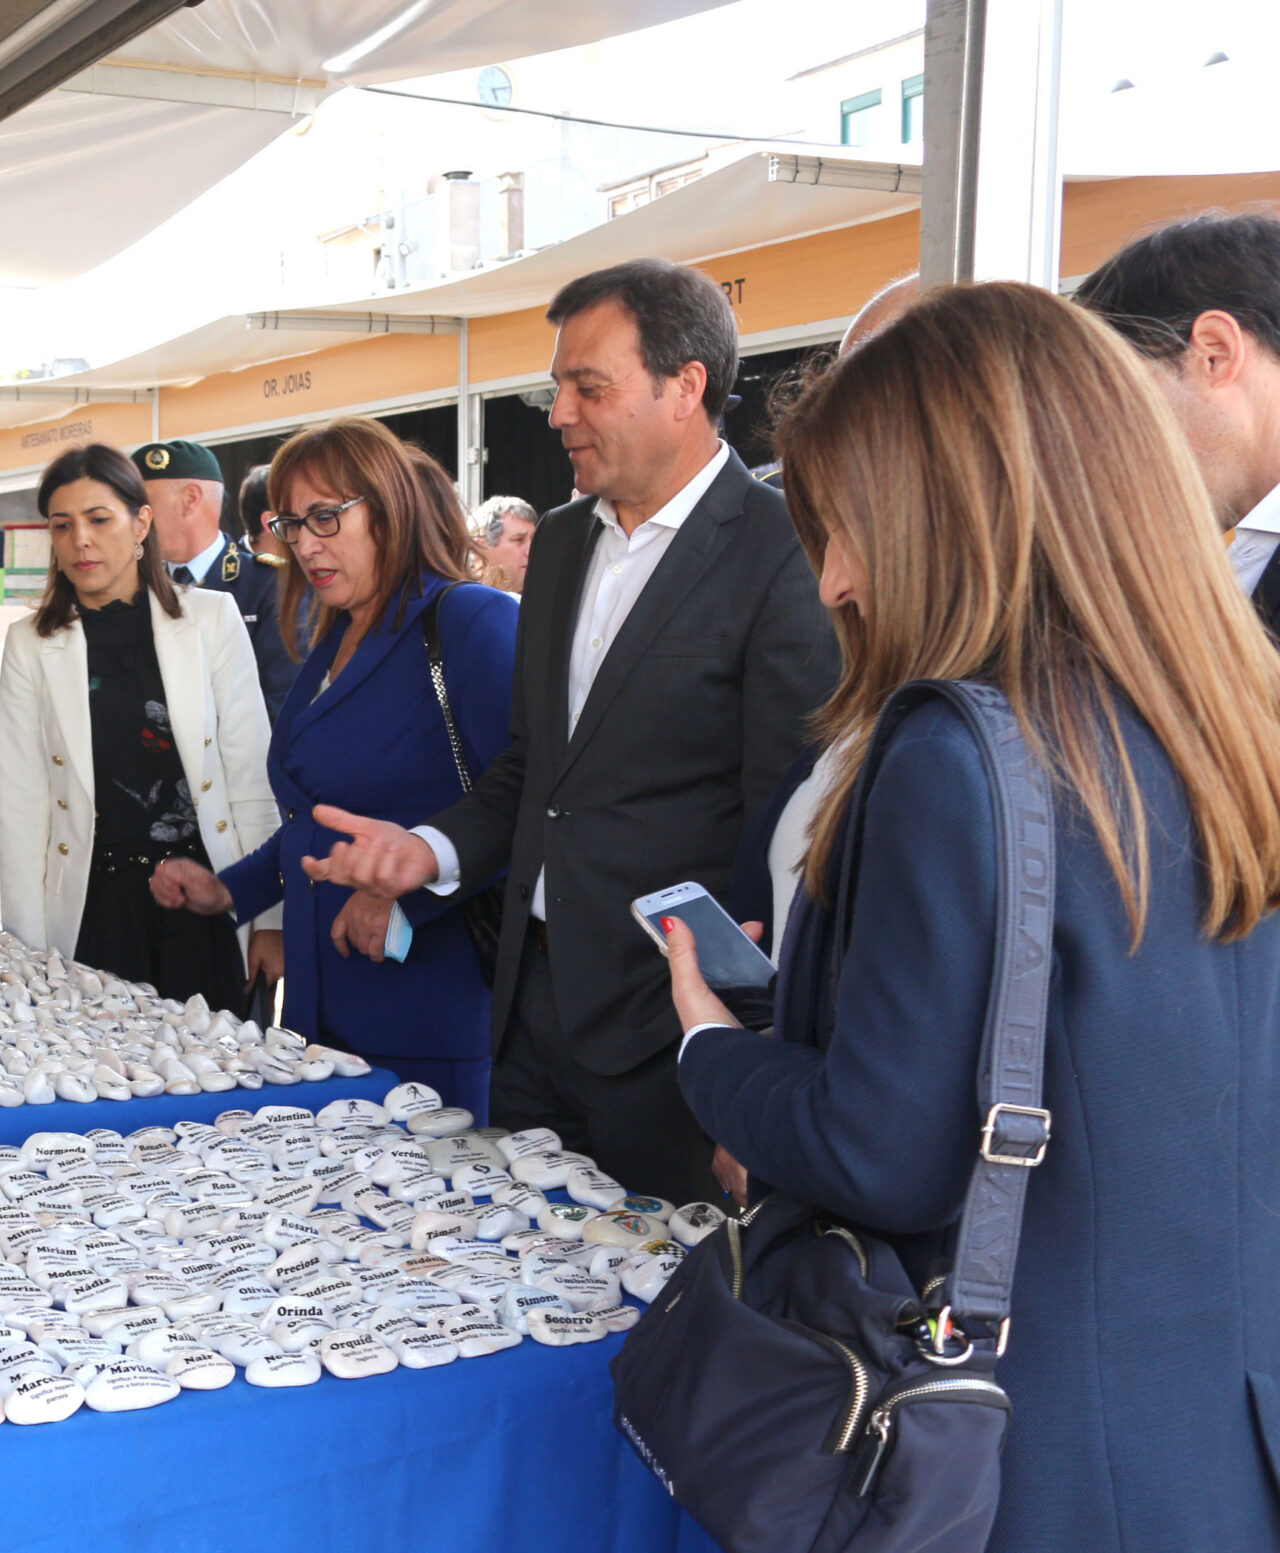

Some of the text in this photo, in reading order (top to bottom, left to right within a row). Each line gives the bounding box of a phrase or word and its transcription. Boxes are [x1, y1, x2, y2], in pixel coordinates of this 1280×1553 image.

[282, 370, 312, 395] JOIAS
[266, 1112, 311, 1122] Valentina
[286, 1137, 310, 1146] Sónia
[36, 1147, 86, 1155] Normanda
[212, 1182, 236, 1190] Rosa
[37, 1247, 76, 1255] Miriam
[276, 1256, 320, 1276] Preciosa
[48, 1269, 93, 1279] Modesta
[298, 1280, 352, 1298] rudência
[517, 1294, 559, 1307] Simone
[278, 1306, 322, 1316] Orinda
[124, 1318, 158, 1330] Nadir
[545, 1315, 592, 1325] Socorro
[2, 1350, 34, 1364] Mara
[184, 1353, 212, 1364] Nair
